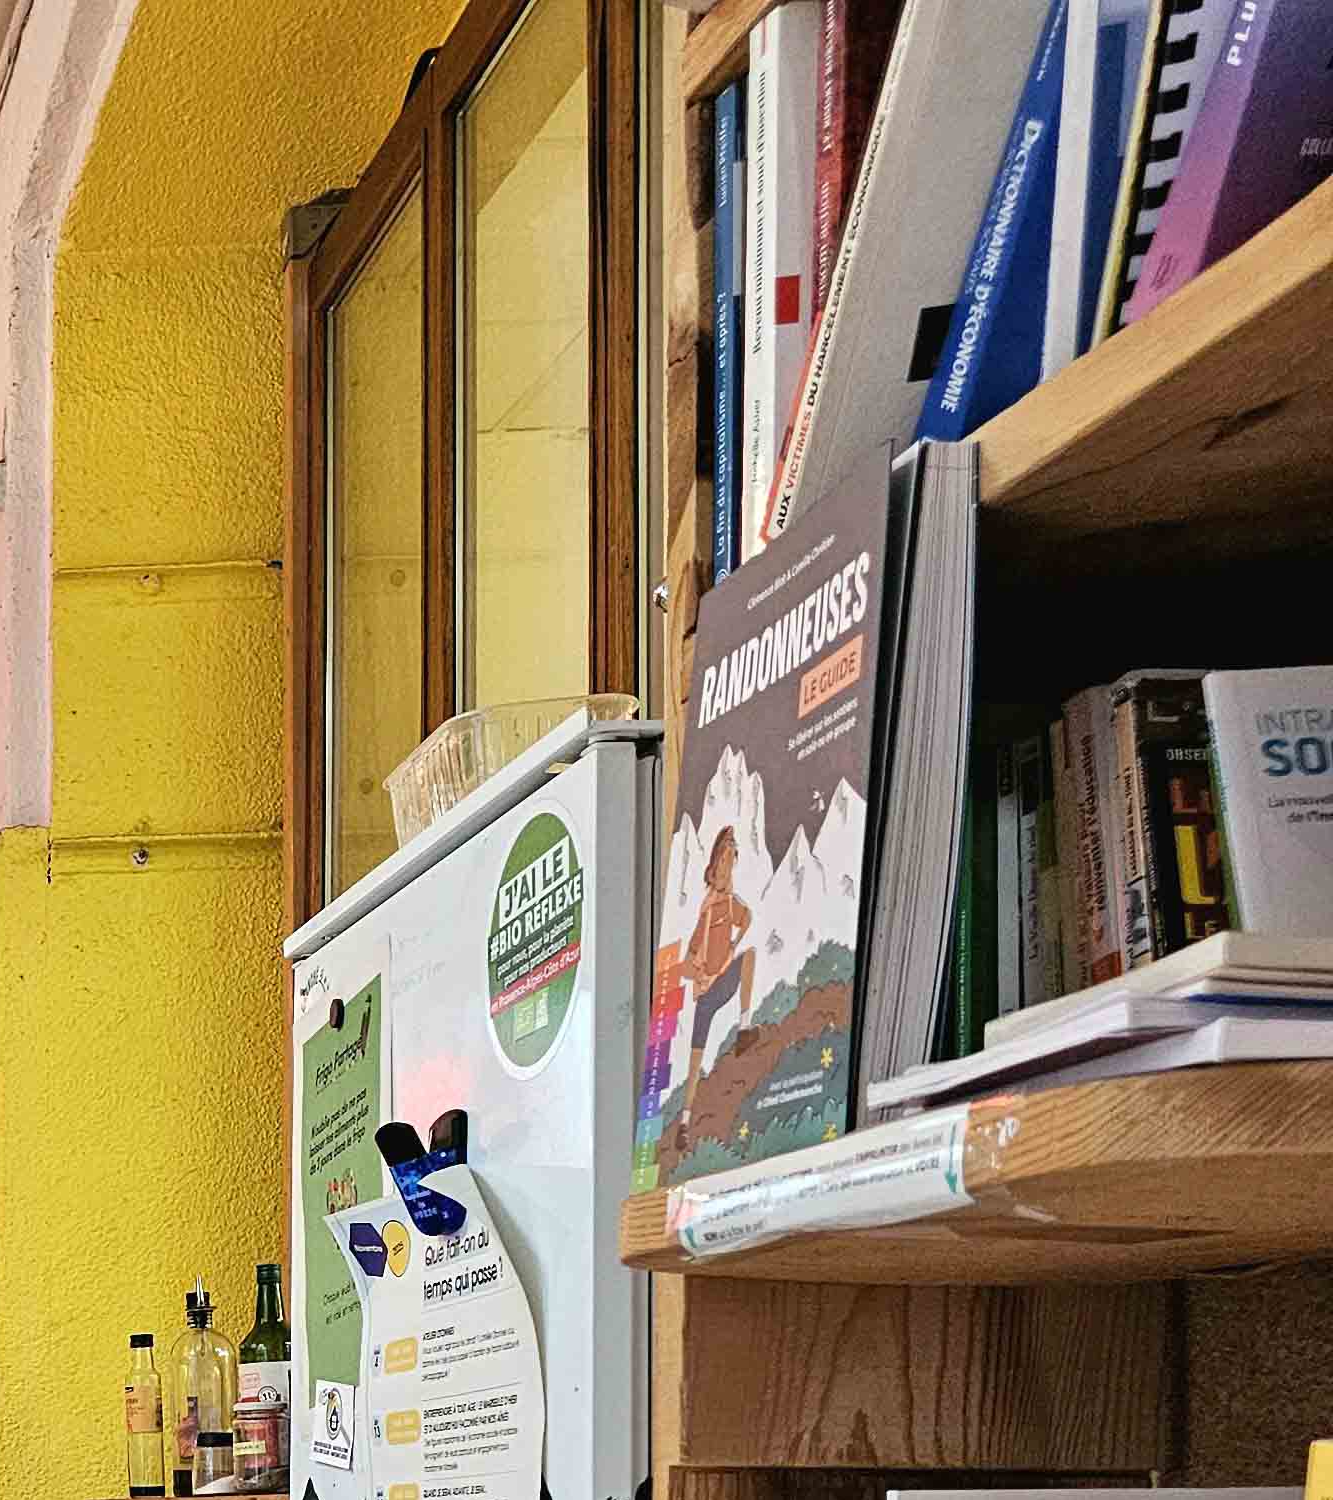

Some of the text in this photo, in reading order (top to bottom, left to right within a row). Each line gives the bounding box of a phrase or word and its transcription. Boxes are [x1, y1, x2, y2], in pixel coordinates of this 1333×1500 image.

[940, 119, 1043, 414] DICTIONNAIRE D'ÉCONOMIE
[811, 247, 851, 382] HARCÈLEMENT
[806, 385, 819, 407] DU
[786, 411, 812, 489] VICTIMES
[717, 486, 727, 507] du
[776, 494, 791, 529] AUX
[697, 551, 870, 729] RANDONNEUSES
[803, 651, 857, 704] LE GUIDE
[504, 845, 564, 920] J'AI LE
[489, 872, 583, 963] #BIO RÉFLEXE
[424, 1225, 490, 1267] Que fait-on du
[423, 1262, 498, 1301] temps qui passe
